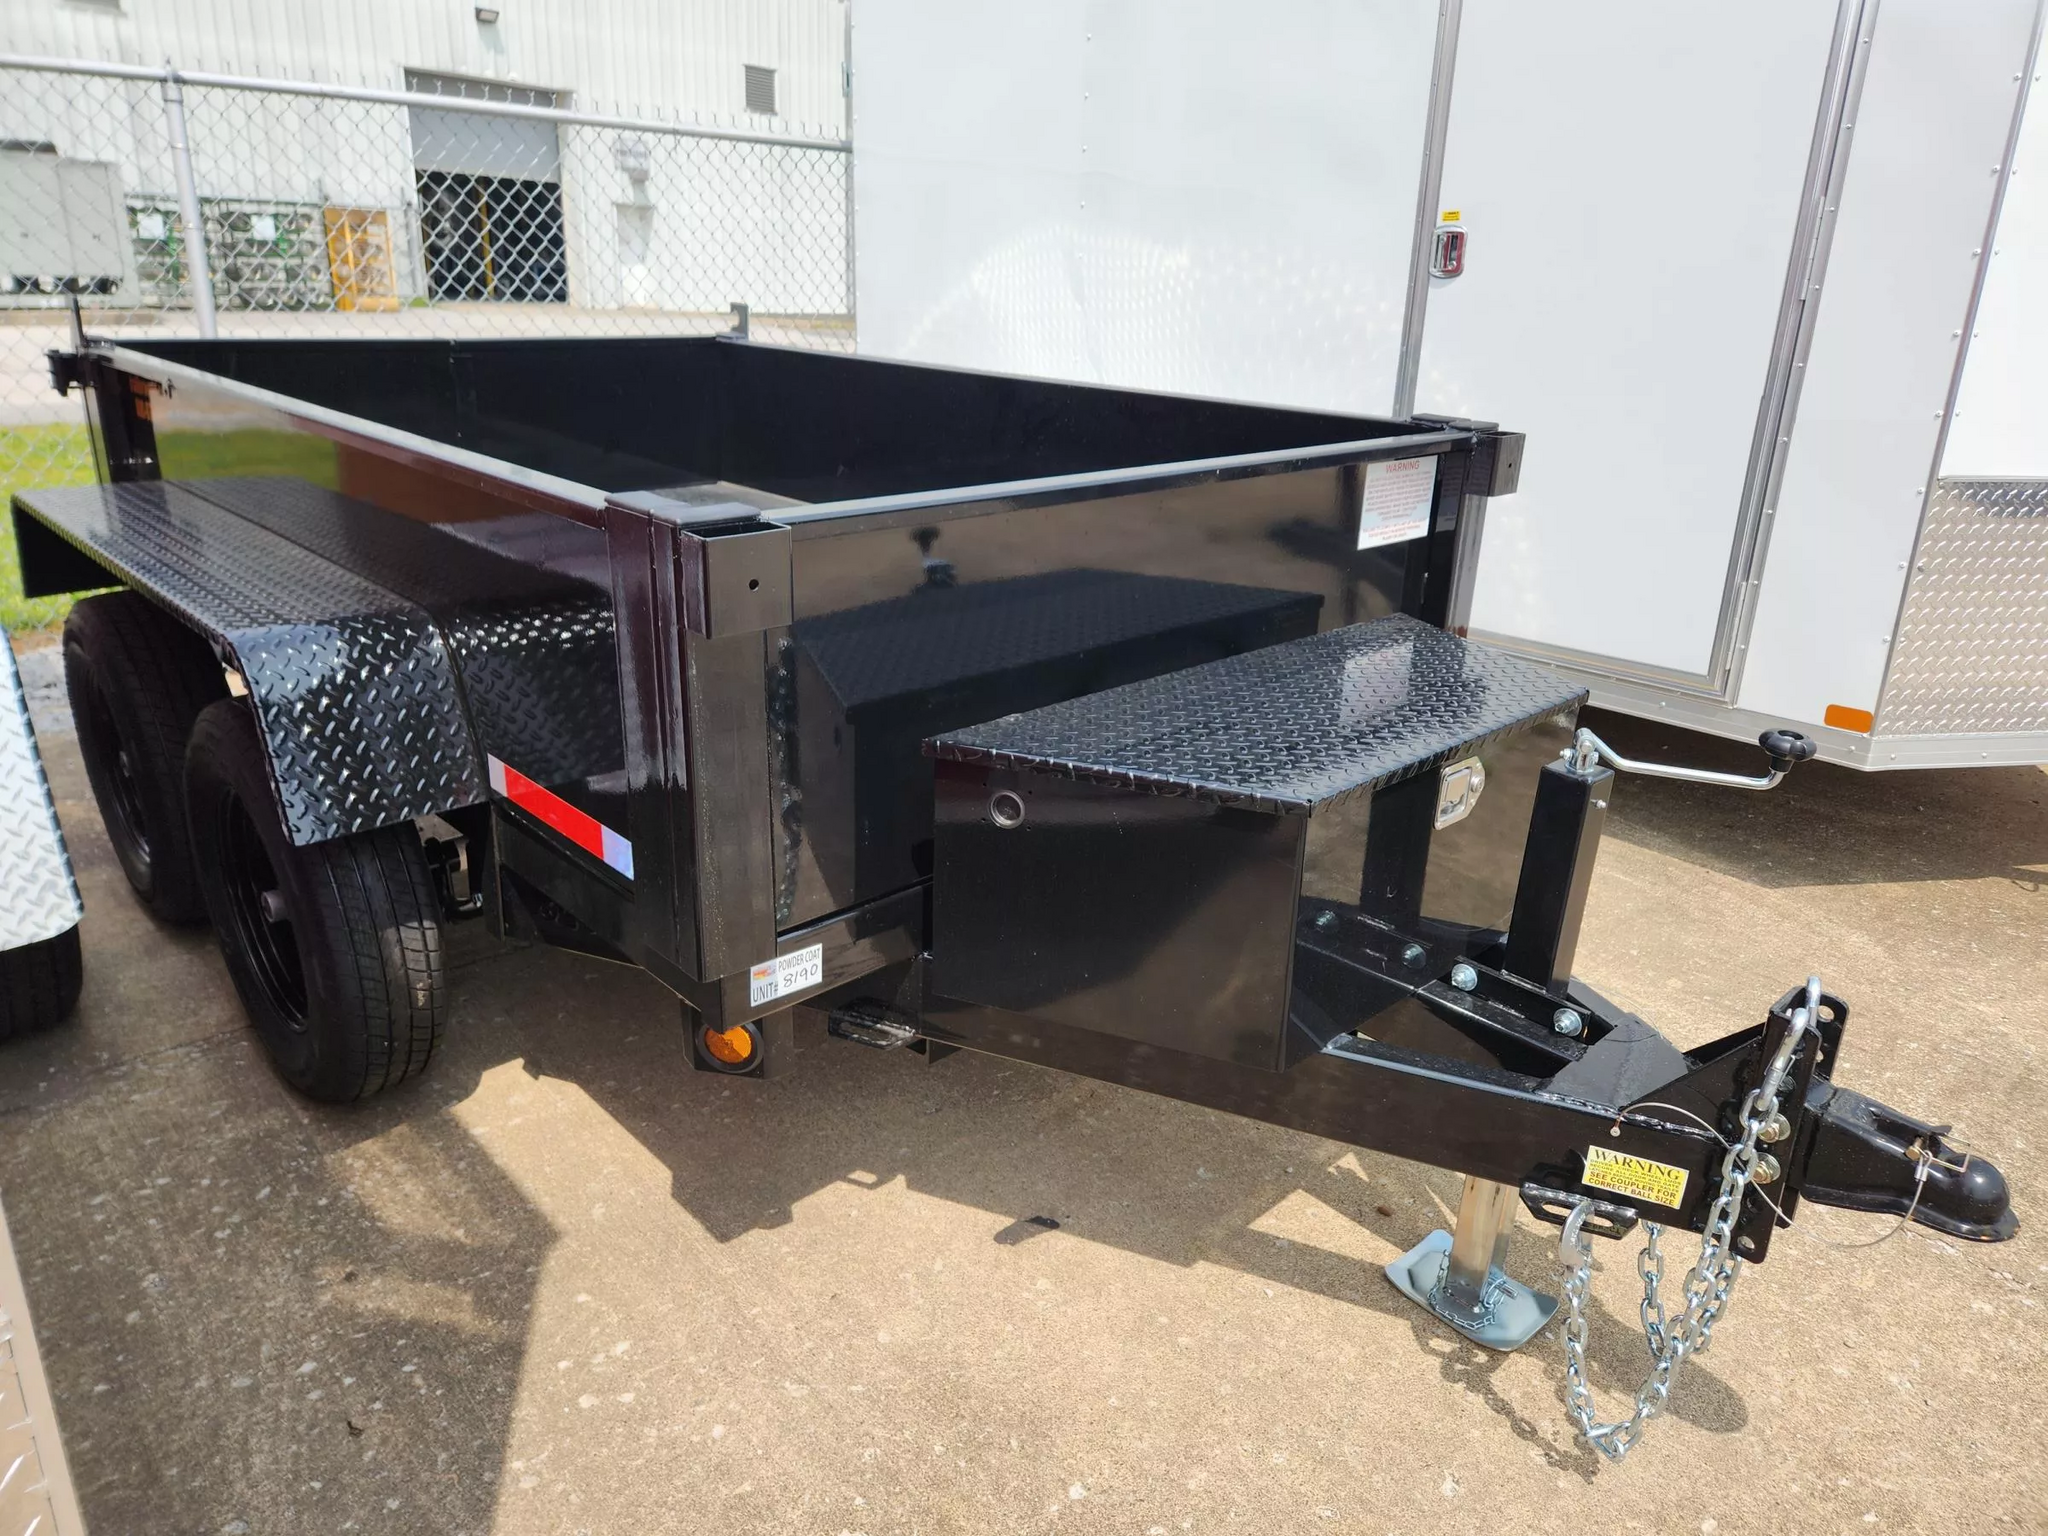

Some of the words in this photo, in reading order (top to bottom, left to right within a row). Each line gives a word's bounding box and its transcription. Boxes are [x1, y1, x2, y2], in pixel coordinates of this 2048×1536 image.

[1385, 460, 1420, 473] WARNING
[778, 953, 804, 972] POWDER
[805, 948, 820, 963] COAT
[783, 963, 818, 988] 8190
[752, 981, 779, 1002] UNIT#
[1590, 1163, 1613, 1171] SECURE
[1590, 1159, 1613, 1167] DRIVER
[1618, 1166, 1638, 1174] CHECK
[1641, 1172, 1662, 1180] WHEEL
[1594, 1149, 1681, 1180] WARNING
[1588, 1166, 1612, 1175] LATCHES
[1613, 1173, 1633, 1181] BEFORE
[1635, 1179, 1655, 1187] MOVING
[1590, 1171, 1608, 1180] SEE
[1610, 1176, 1654, 1193] COUPLER
[1657, 1189, 1677, 1199] FOR
[1588, 1177, 1629, 1193] CORRECT
[1630, 1188, 1653, 1199] BALL
[1654, 1195, 1675, 1206] SIZE
